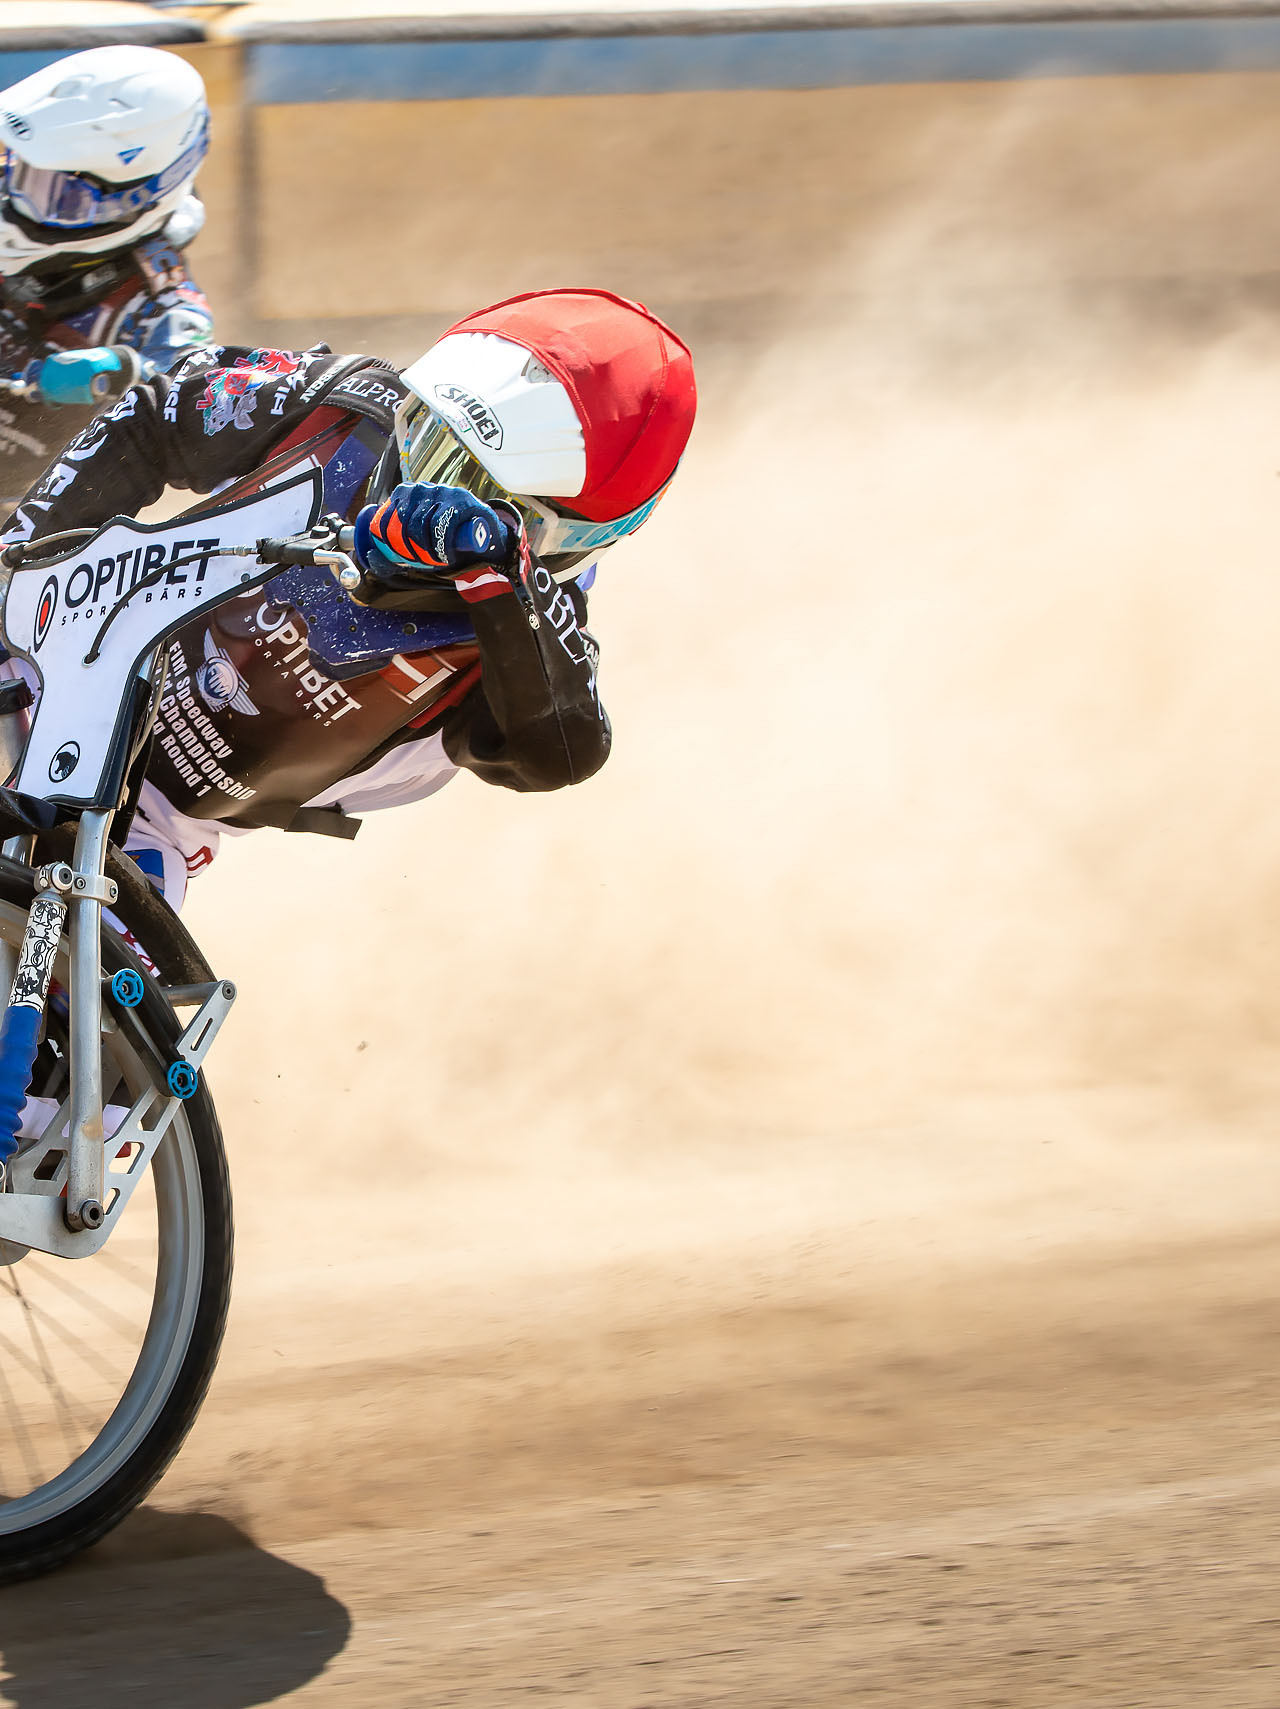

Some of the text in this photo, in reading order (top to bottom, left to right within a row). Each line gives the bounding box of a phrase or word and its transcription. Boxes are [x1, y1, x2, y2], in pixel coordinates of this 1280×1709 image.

[441, 388, 500, 441] SHOEI
[65, 538, 220, 609] OPTIBET
[145, 586, 202, 603] BĀRS
[243, 614, 289, 680] SPORTA
[256, 601, 363, 721] OPTIBET
[170, 640, 234, 759] FIM Speedway
[159, 694, 258, 801] Championship
[160, 733, 213, 798] Round 1
